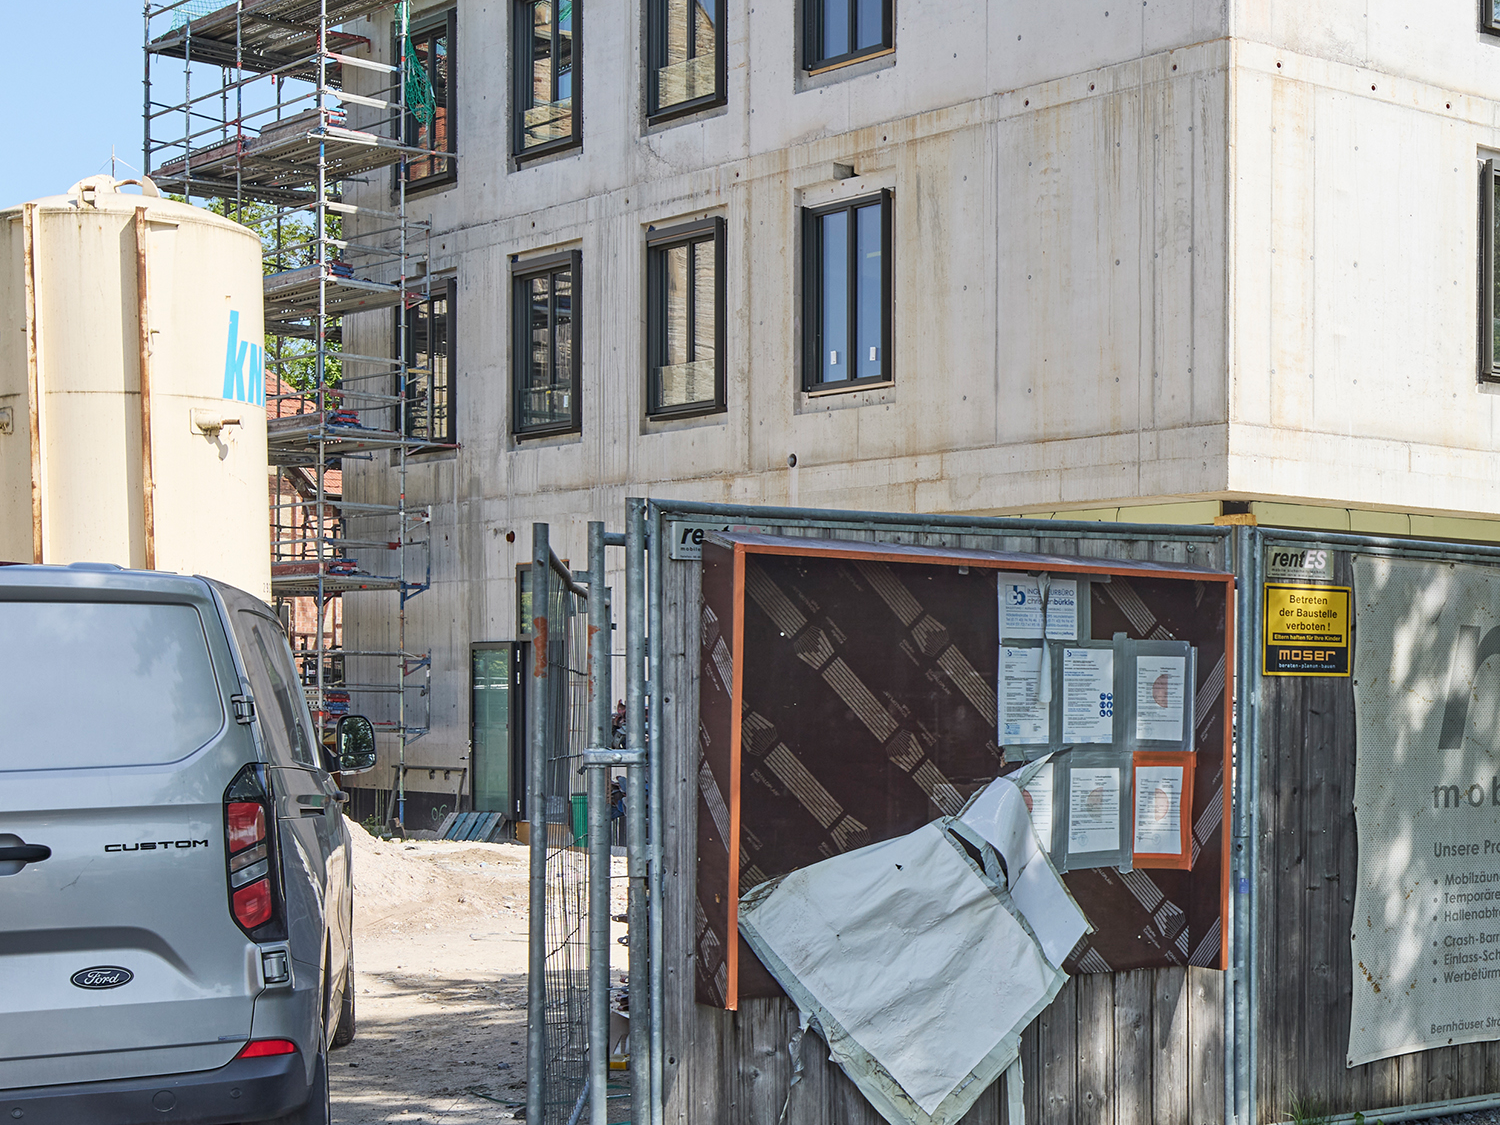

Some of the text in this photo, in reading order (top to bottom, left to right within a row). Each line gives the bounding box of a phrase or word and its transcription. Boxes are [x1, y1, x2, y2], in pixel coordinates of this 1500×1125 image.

[1272, 550, 1327, 569] rentES
[1290, 595, 1328, 605] Betreten
[1279, 608, 1337, 618] der Baustelle
[1279, 649, 1336, 661] moser
[105, 839, 209, 853] CUSTOM
[1434, 841, 1479, 858] Unsere
[1444, 888, 1500, 906] Temporäre
[84, 970, 119, 984] Ford
[1430, 1019, 1484, 1035] Bernhäuser
